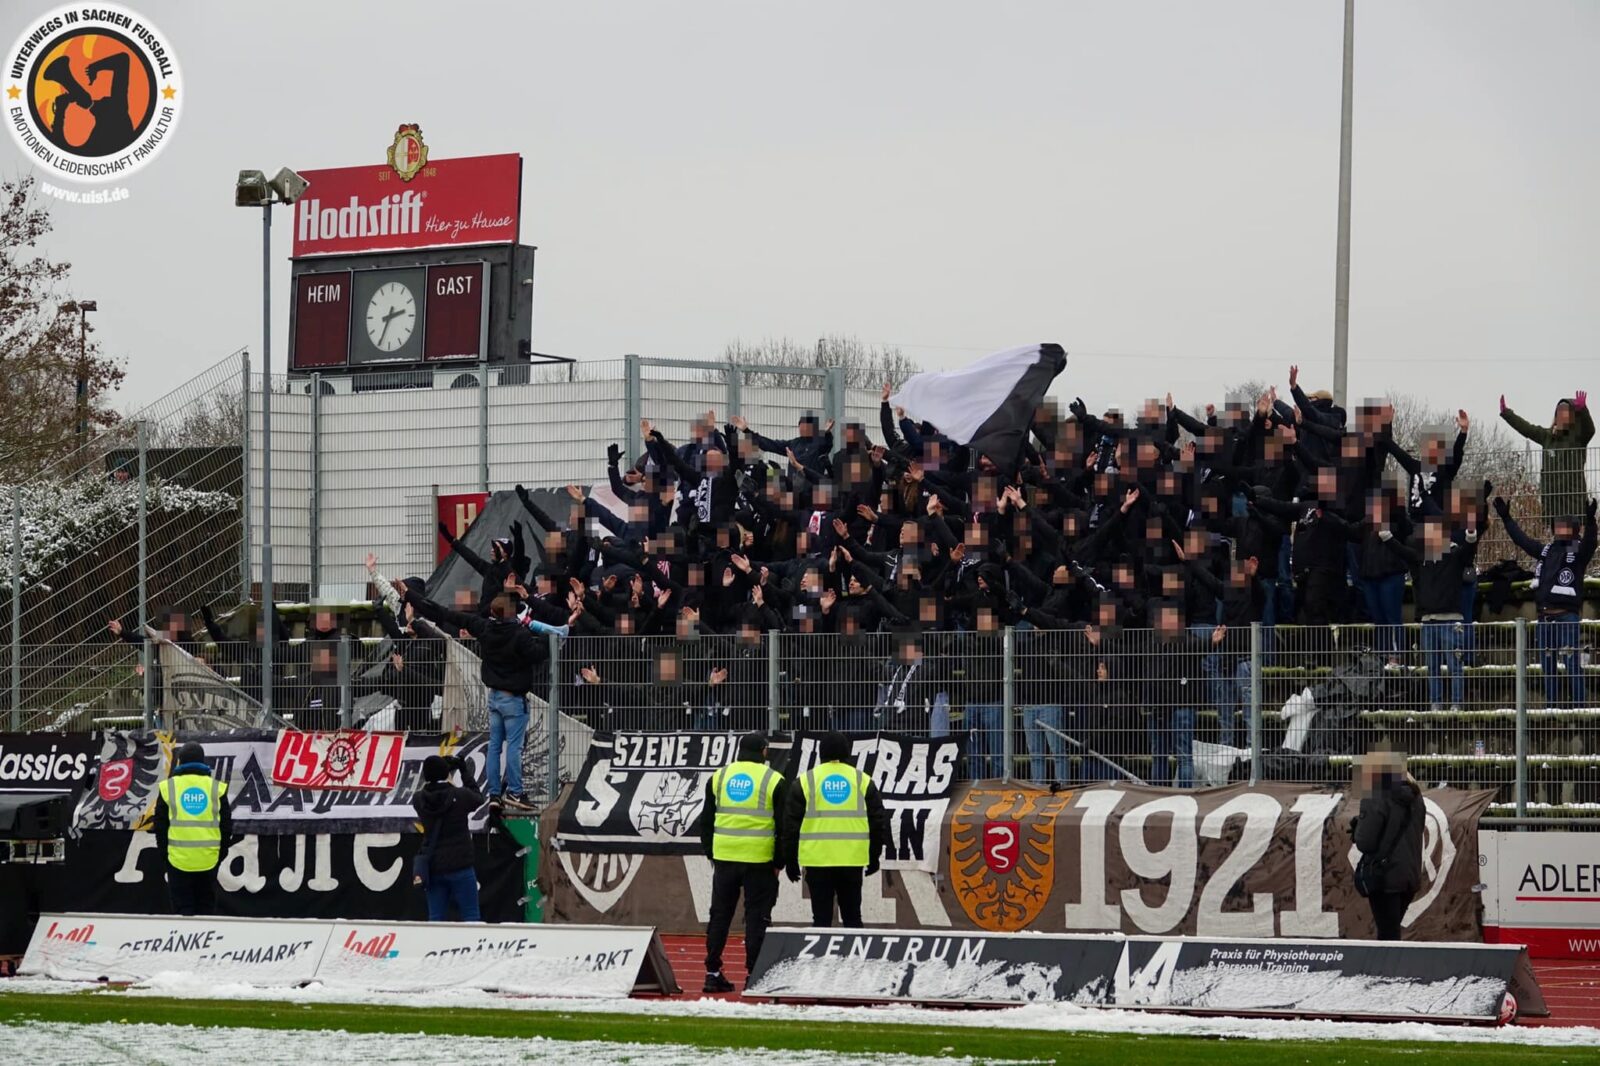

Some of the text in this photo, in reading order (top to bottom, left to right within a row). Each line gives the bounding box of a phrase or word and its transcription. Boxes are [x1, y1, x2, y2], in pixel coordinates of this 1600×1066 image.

[298, 189, 423, 241] Hochstift
[424, 210, 513, 239] Hier zu Hause
[307, 284, 341, 303] HEIM
[436, 276, 473, 295] GAST
[613, 735, 742, 767] SZENE 191
[796, 737, 959, 795] UTRAS
[729, 778, 752, 790] RHP
[824, 780, 848, 791] RHP
[183, 793, 206, 803] RHP
[1064, 789, 1344, 937] 1921
[798, 934, 986, 966] ZENTRUM
[1210, 948, 1344, 962] Praxis für Physiotherapie
[1266, 962, 1309, 973] Training
